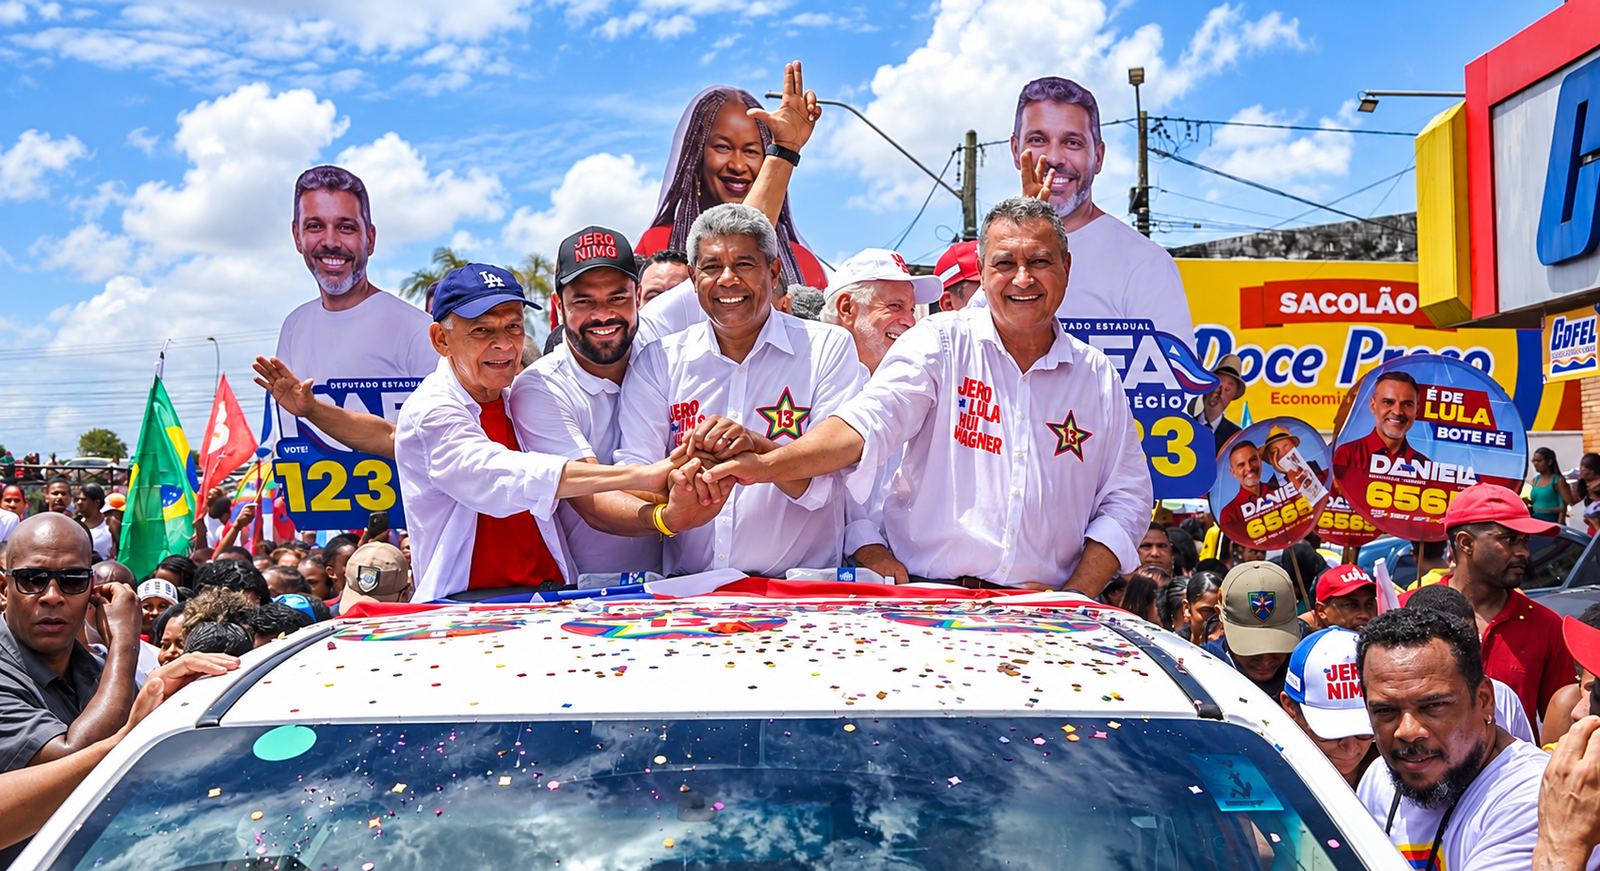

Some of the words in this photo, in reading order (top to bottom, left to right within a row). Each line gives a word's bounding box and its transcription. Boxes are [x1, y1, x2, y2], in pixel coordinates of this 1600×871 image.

[573, 232, 616, 249] JERO
[575, 244, 619, 263] NIMO
[479, 271, 505, 289] LA
[1279, 286, 1417, 315] SACOLÃO
[1060, 322, 1091, 331] TADO
[1096, 322, 1150, 331] ESTADUAL
[1194, 327, 1324, 385] Doce
[330, 381, 379, 389] DEPUTADO
[382, 381, 422, 389] ESTADUA
[958, 376, 992, 404] JERO
[1126, 392, 1182, 409] ÉCIO
[1271, 391, 1346, 406] Economi
[1426, 386, 1438, 401] É
[1441, 390, 1464, 404] DE
[670, 399, 700, 423] JERO
[775, 410, 795, 428] 13
[968, 399, 1001, 424] LULA
[1423, 401, 1491, 427] LULA
[953, 424, 1003, 455] WAGNER
[1062, 428, 1077, 445] 13
[1437, 427, 1482, 443] BOTE
[1485, 432, 1507, 446] FÉ
[284, 445, 309, 454] VOTE!
[275, 459, 397, 512] 123
[1240, 481, 1299, 518] DANIE
[1326, 663, 1361, 682] JER
[1327, 681, 1363, 700] NIM
